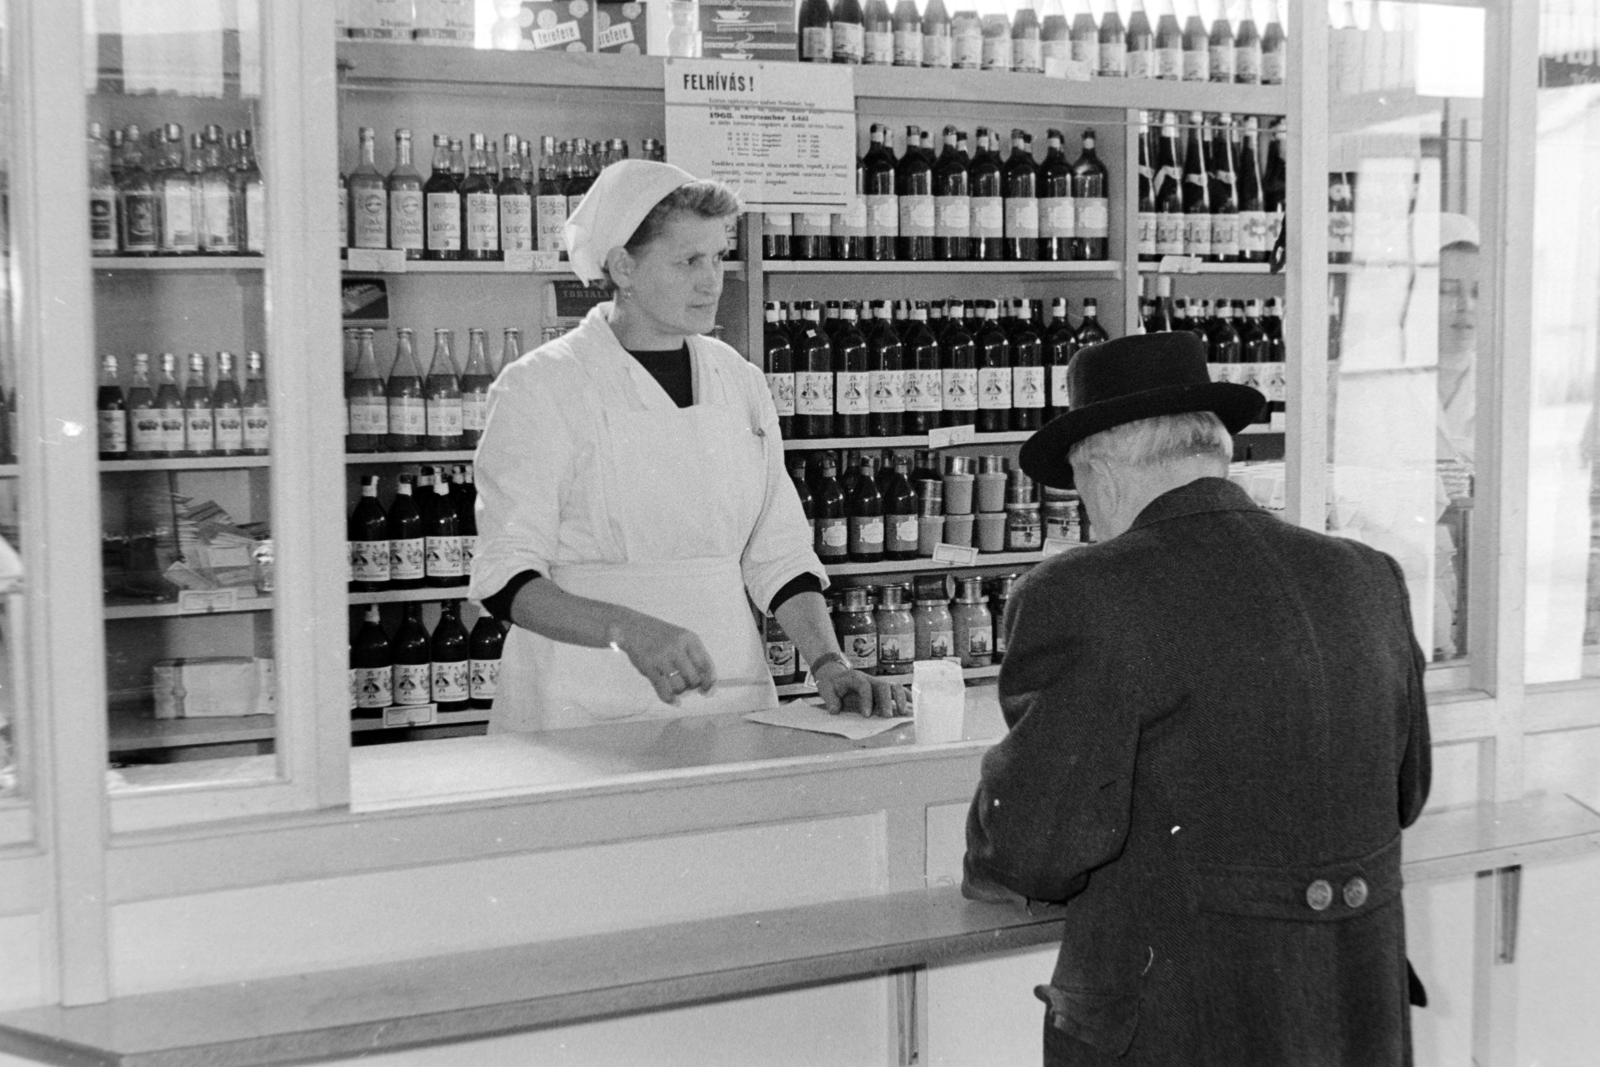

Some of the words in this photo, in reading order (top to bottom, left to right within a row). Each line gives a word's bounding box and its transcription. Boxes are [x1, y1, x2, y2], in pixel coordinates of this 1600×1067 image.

[538, 26, 575, 45] terefere
[683, 71, 754, 92] FELHÍVÁS!
[740, 113, 786, 121] szeptember
